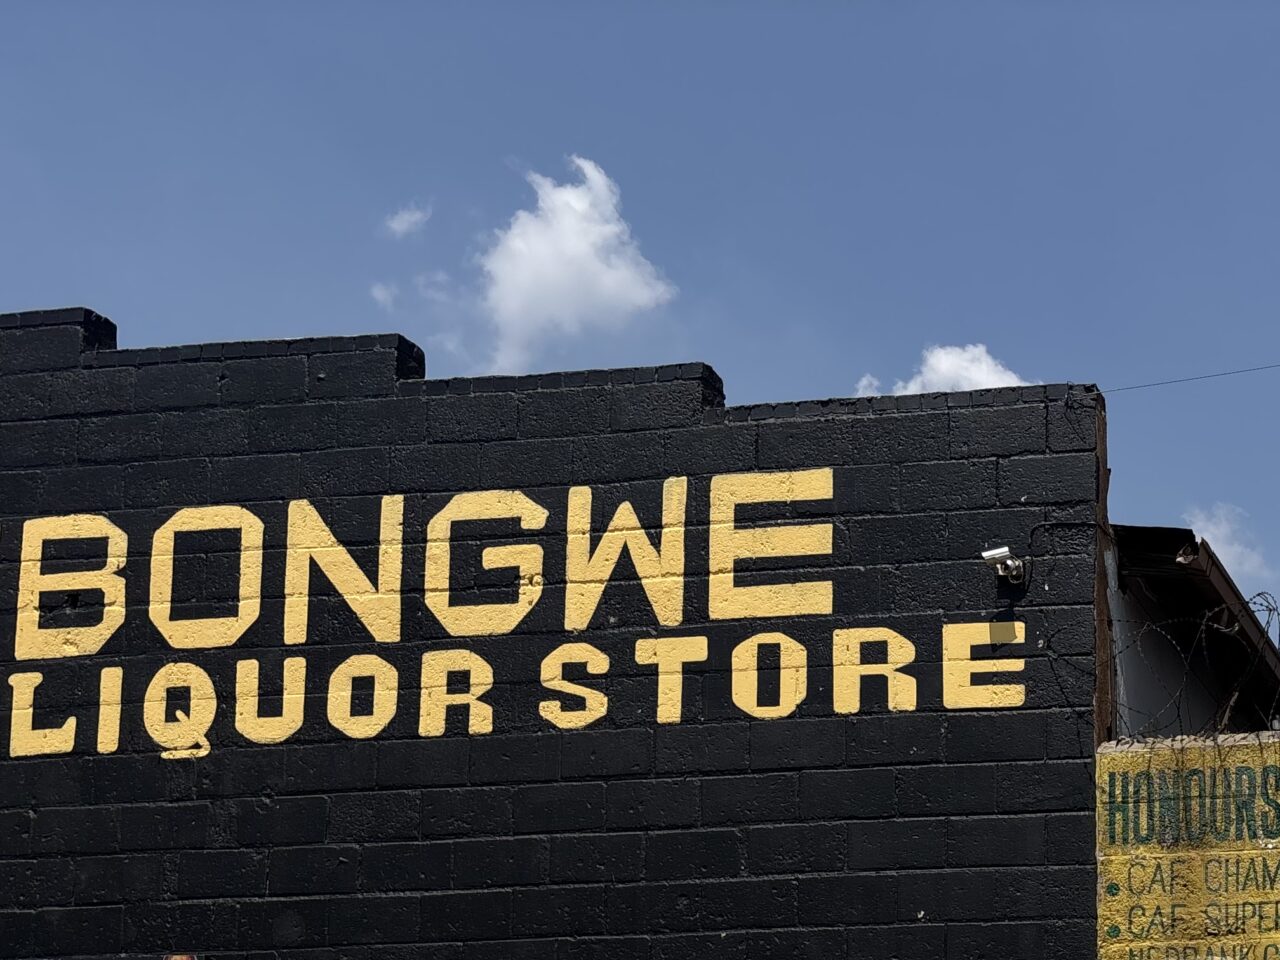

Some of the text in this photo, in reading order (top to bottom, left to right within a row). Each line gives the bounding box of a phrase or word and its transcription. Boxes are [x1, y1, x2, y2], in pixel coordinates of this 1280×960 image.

[14, 467, 834, 660] BONGWE
[8, 621, 1026, 759] LIQUOR STORE
[1127, 859, 1187, 897] CAF
[1127, 903, 1187, 938] CAF
